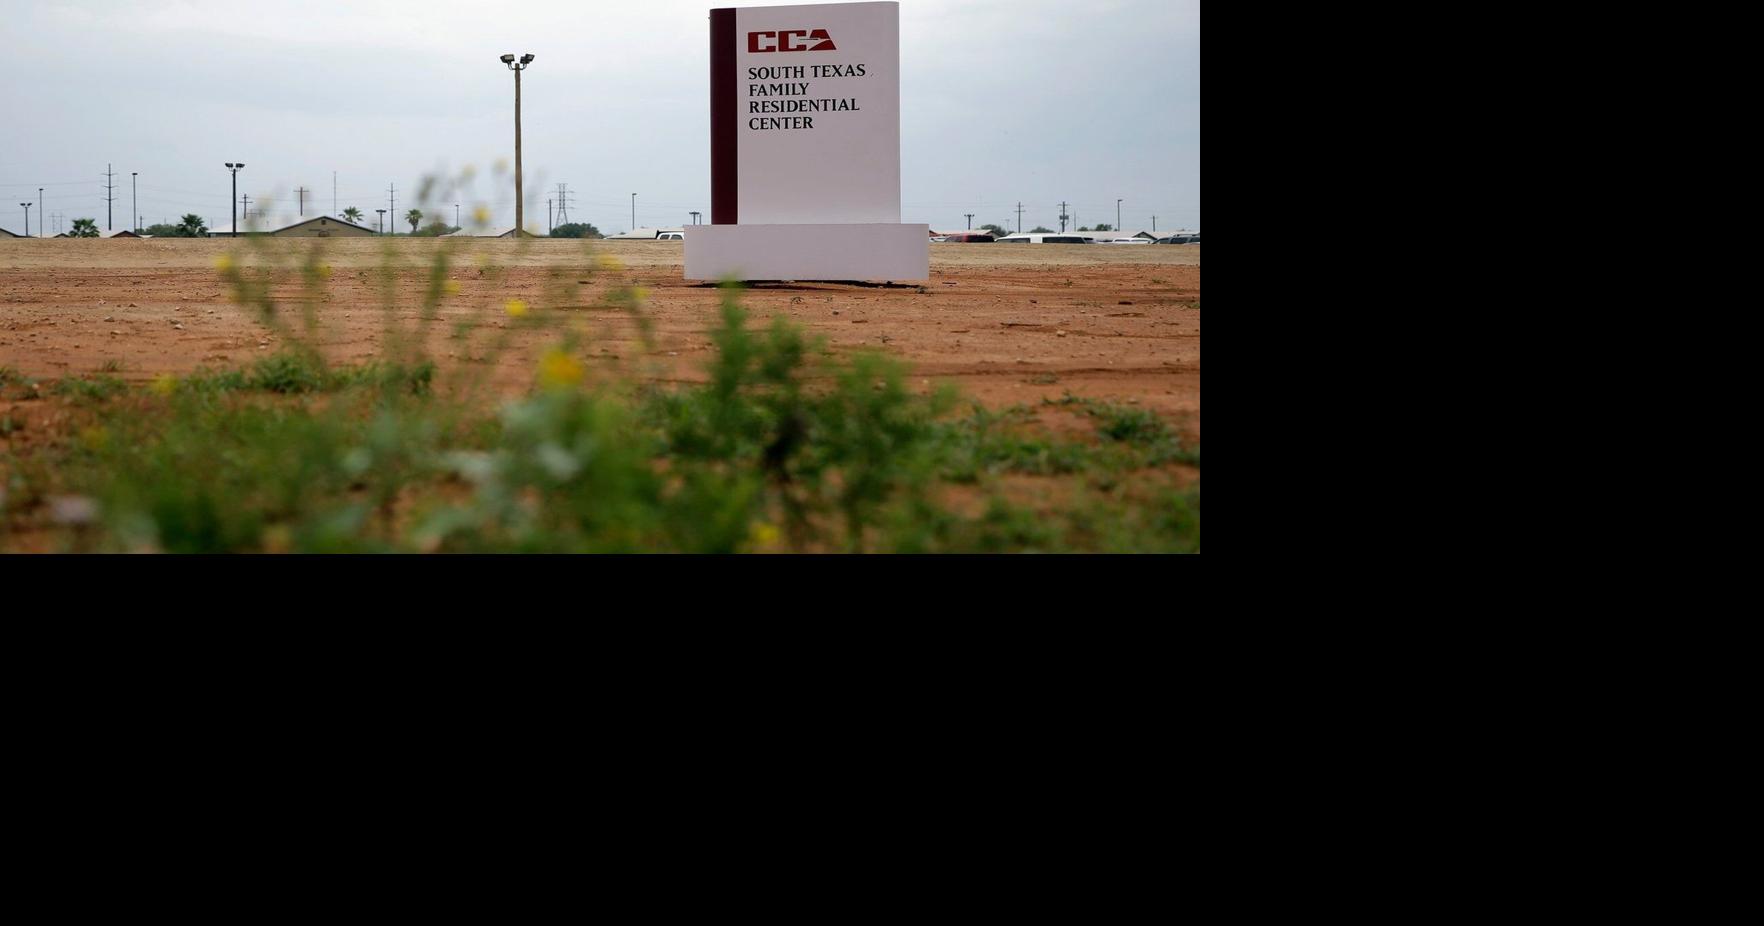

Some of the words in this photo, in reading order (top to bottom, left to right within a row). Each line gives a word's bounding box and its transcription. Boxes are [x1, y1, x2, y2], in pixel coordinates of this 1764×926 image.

[748, 29, 837, 53] CCA
[748, 66, 805, 80] SOUTH
[810, 64, 866, 78] TEXAS
[749, 83, 810, 97] FAMILY
[749, 98, 860, 114] RESIDENTIAL
[748, 116, 814, 130] CENTER
